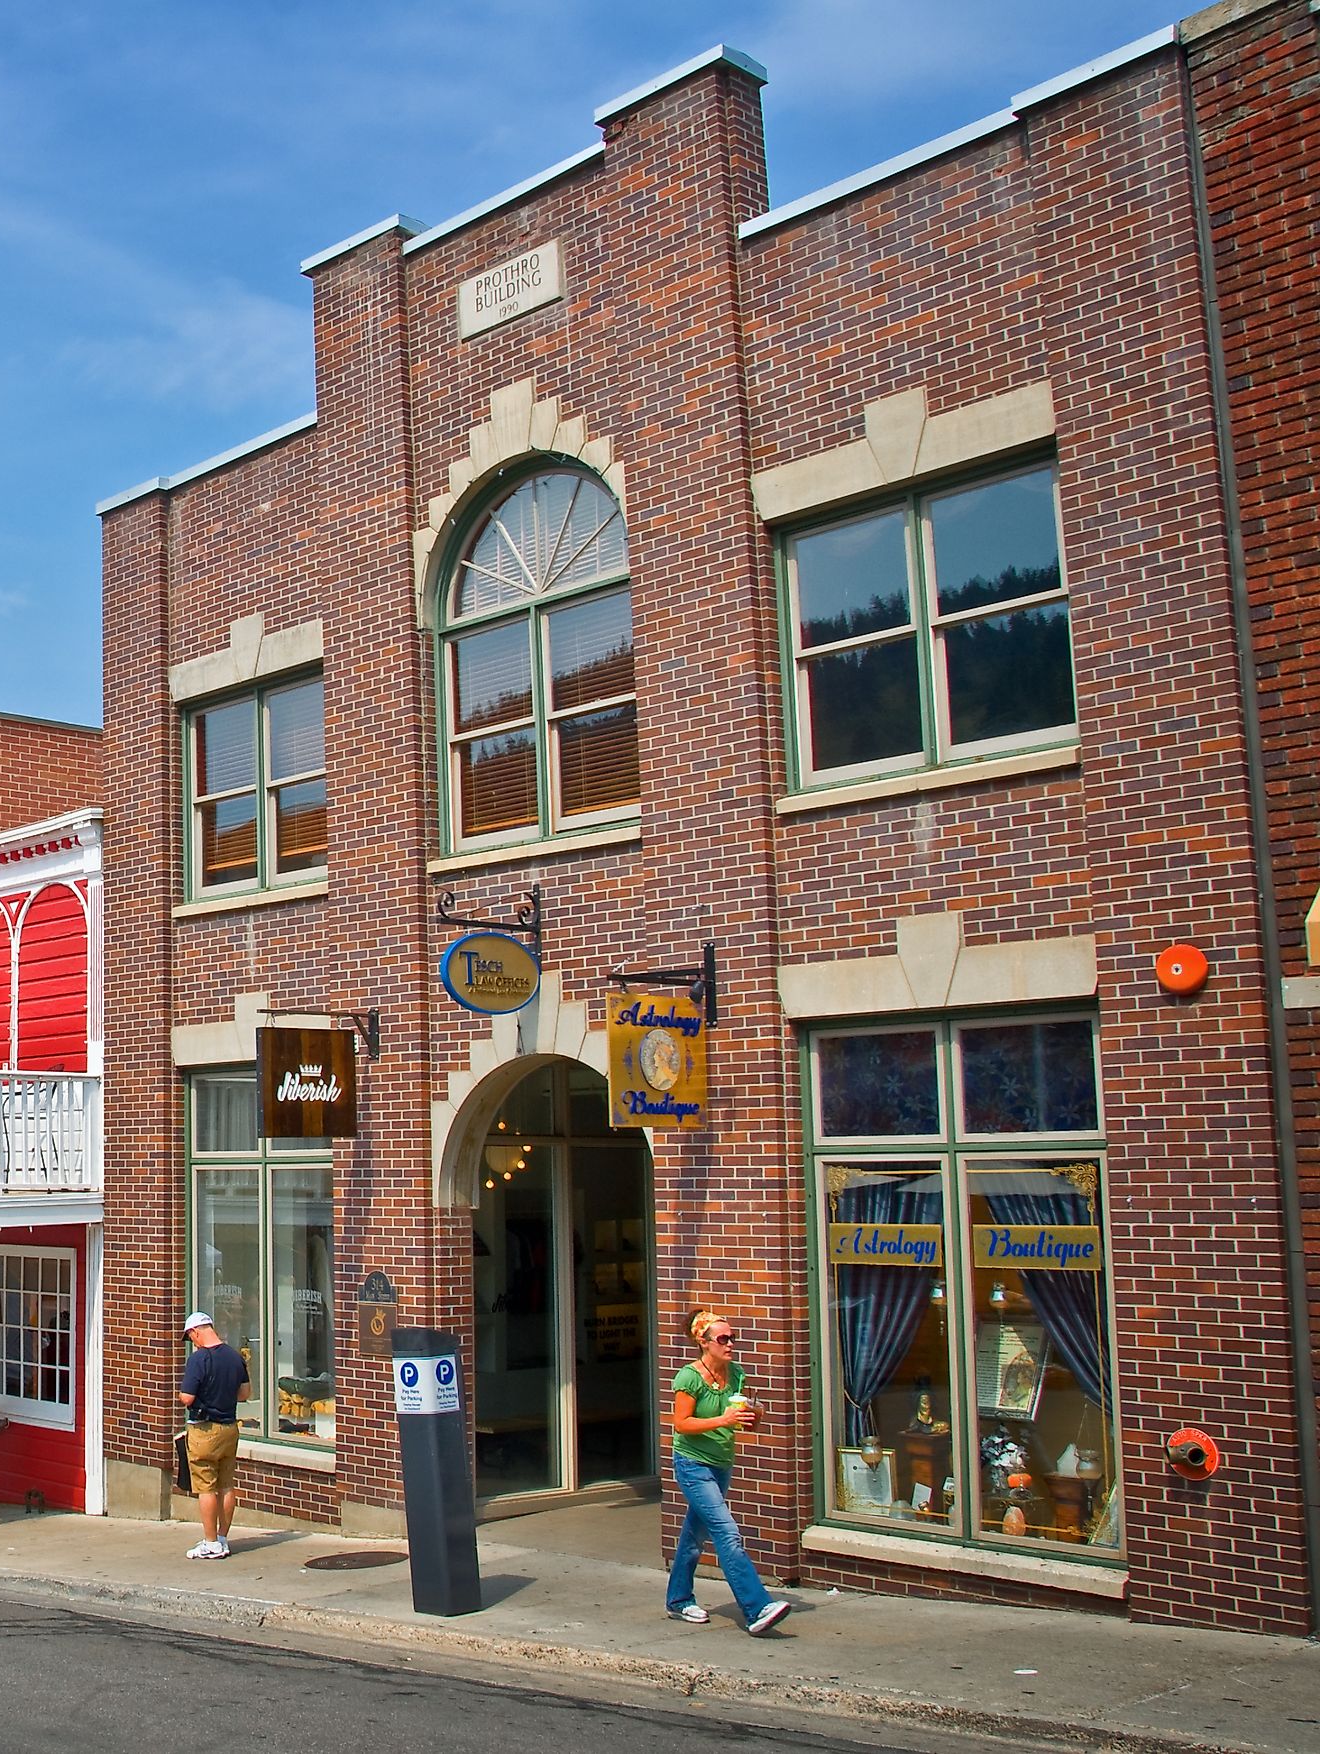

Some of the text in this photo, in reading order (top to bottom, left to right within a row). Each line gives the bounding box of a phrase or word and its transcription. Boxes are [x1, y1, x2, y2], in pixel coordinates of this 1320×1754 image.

[475, 270, 541, 312] BUILDING
[476, 254, 539, 295] PROTHRO
[499, 301, 519, 318] 1990
[495, 976, 529, 988] OFFICES
[615, 1001, 701, 1037] Astrology
[277, 1071, 342, 1103] Jiberish
[622, 1090, 700, 1122] Boutique
[835, 1228, 937, 1264] Astrology
[988, 1229, 1095, 1268] Boutique
